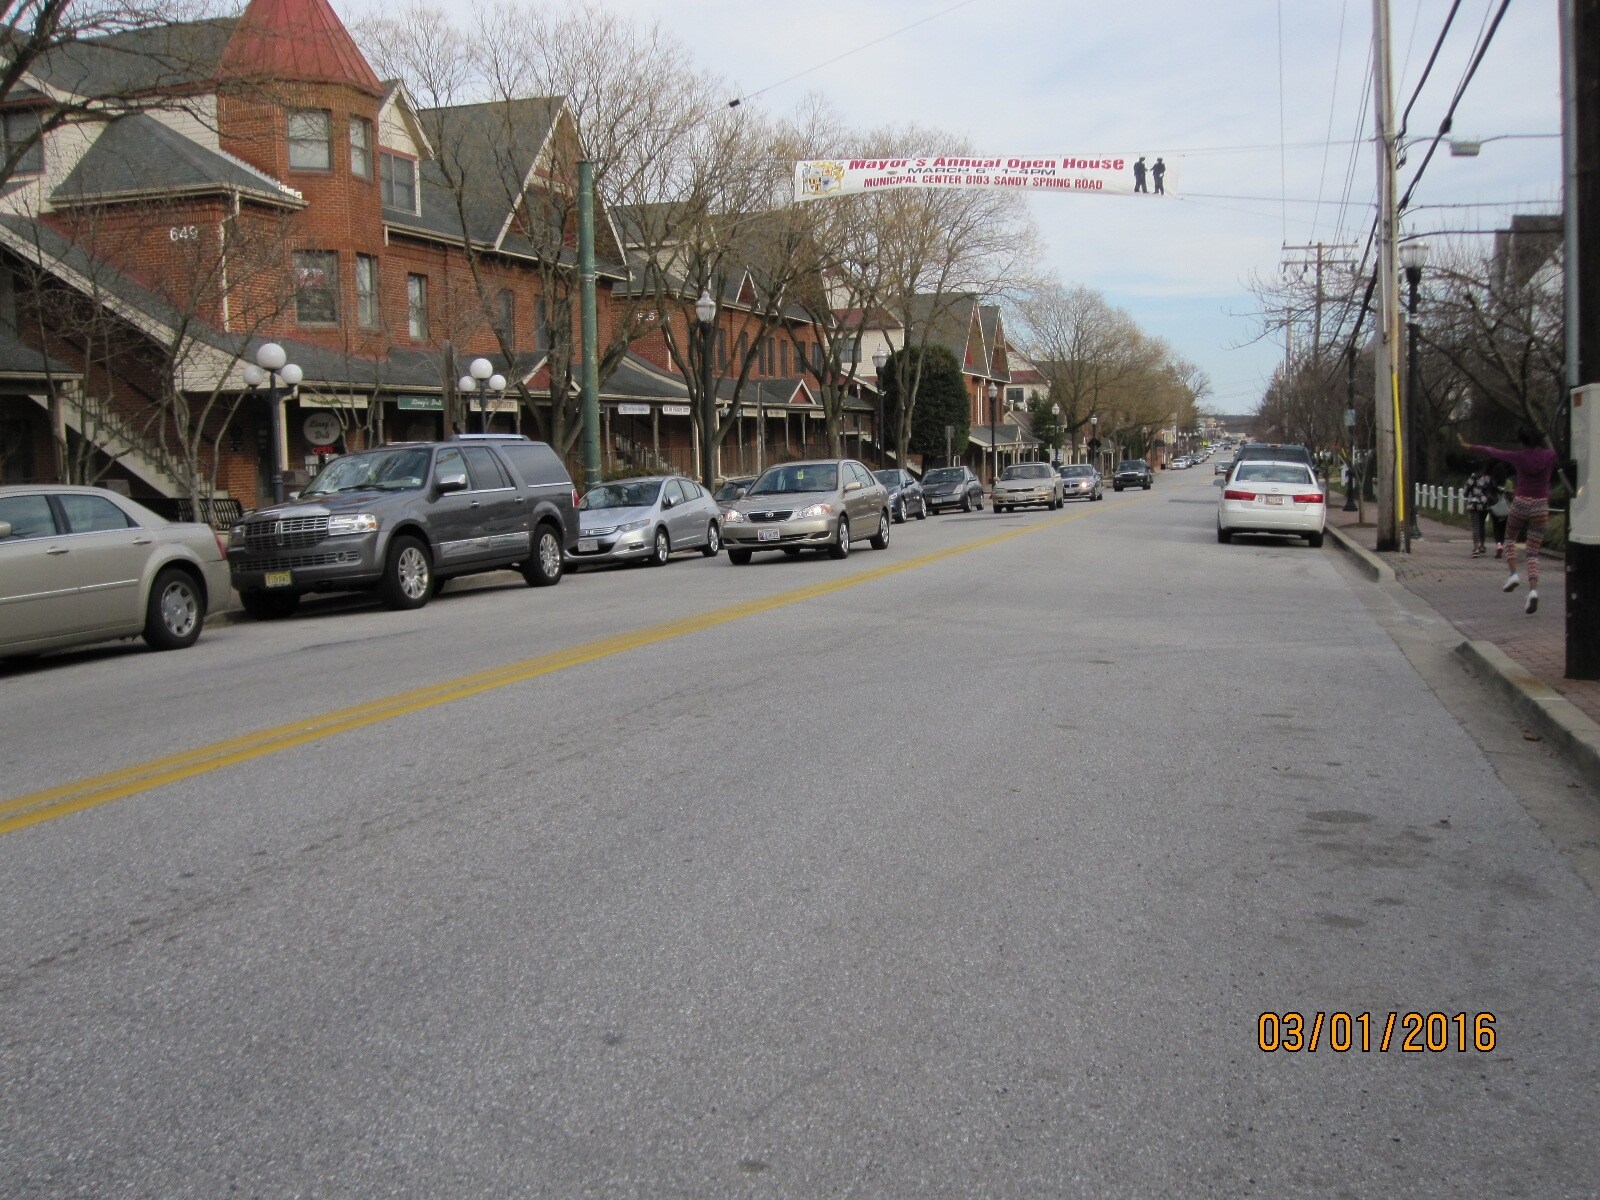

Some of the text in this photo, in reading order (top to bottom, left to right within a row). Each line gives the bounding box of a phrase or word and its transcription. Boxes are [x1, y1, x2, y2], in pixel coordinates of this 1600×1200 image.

[848, 157, 1125, 170] Mayor's Annual Open House
[863, 174, 1103, 190] MUNICIPAL CENTER 8103 SANDY SPRING ROAD
